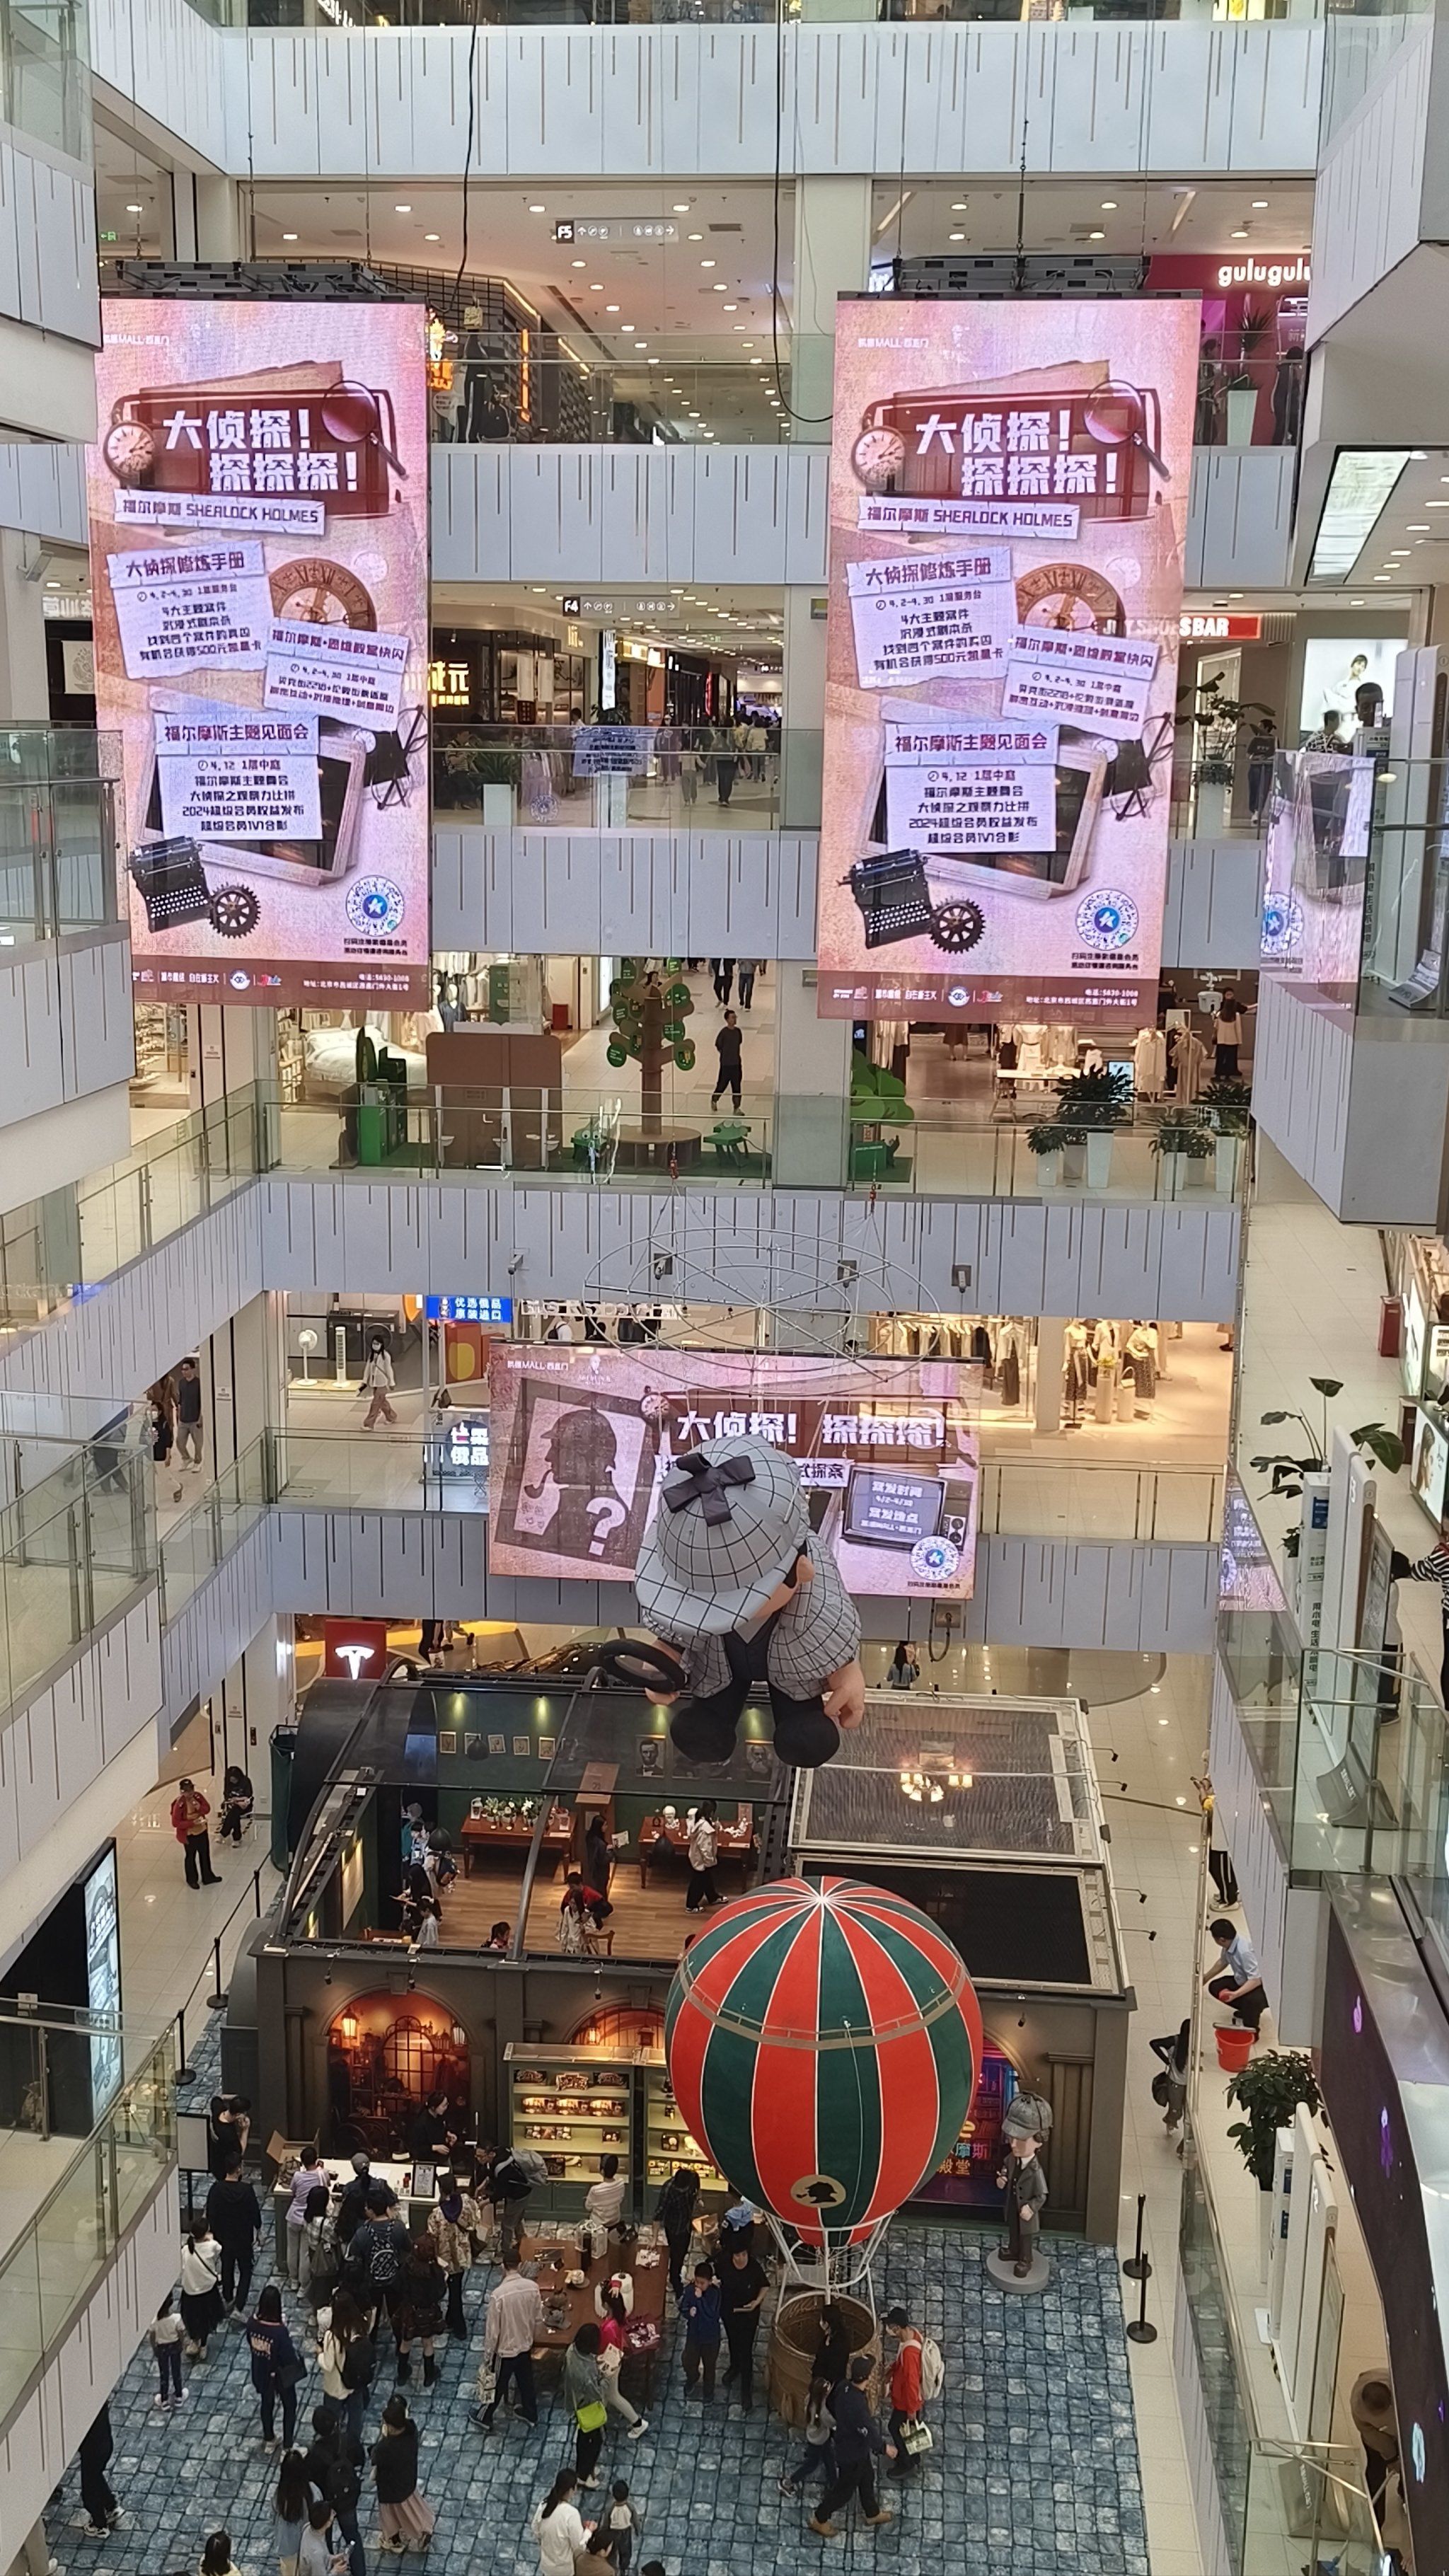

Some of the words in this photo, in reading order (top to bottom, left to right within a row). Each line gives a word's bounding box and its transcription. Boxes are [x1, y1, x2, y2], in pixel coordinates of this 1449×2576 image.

[558, 225, 573, 238] F5
[163, 409, 310, 450] 大侦探!
[916, 409, 1071, 454] 大侦探!
[210, 451, 357, 492] 探探探!
[962, 452, 1118, 496] 探探探!
[123, 499, 181, 517] 福尔摩斯
[186, 503, 258, 521] SHERLOCK
[262, 507, 318, 523] HOLMES
[867, 505, 929, 523] 福尔摩斯
[933, 509, 1008, 526] SHERLOCK
[1012, 512, 1073, 528] HOLMES
[865, 557, 991, 587] 大侦探修炼手册
[565, 600, 579, 613] F4
[165, 723, 308, 741] 福尔摩斯主题见面会
[895, 732, 1047, 752] 福尔摩斯主题见面会
[455, 1309, 502, 1320] 原装进口
